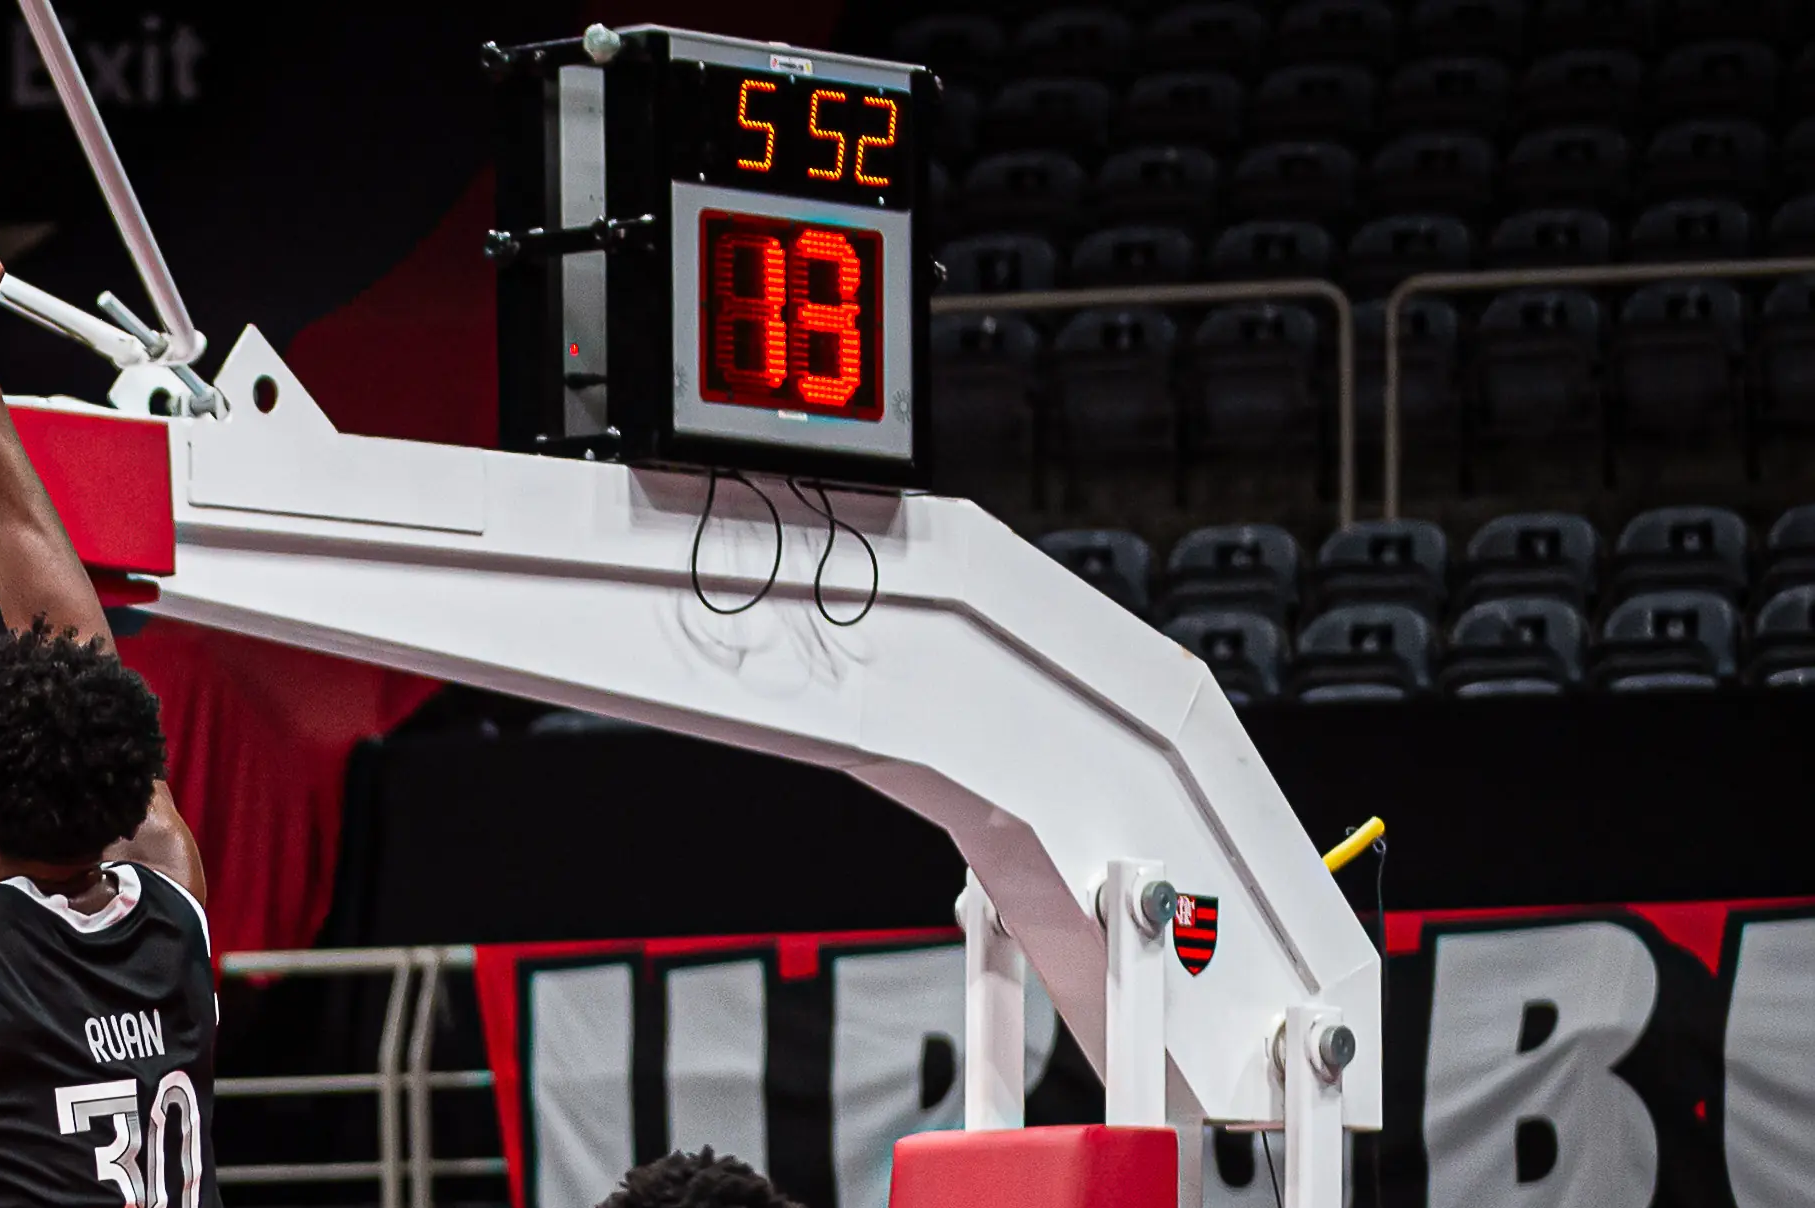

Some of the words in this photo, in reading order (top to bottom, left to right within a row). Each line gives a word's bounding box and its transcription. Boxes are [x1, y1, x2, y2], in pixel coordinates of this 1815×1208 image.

[738, 79, 777, 173] 5
[808, 89, 898, 187] 52
[85, 1008, 165, 1063] RUAN
